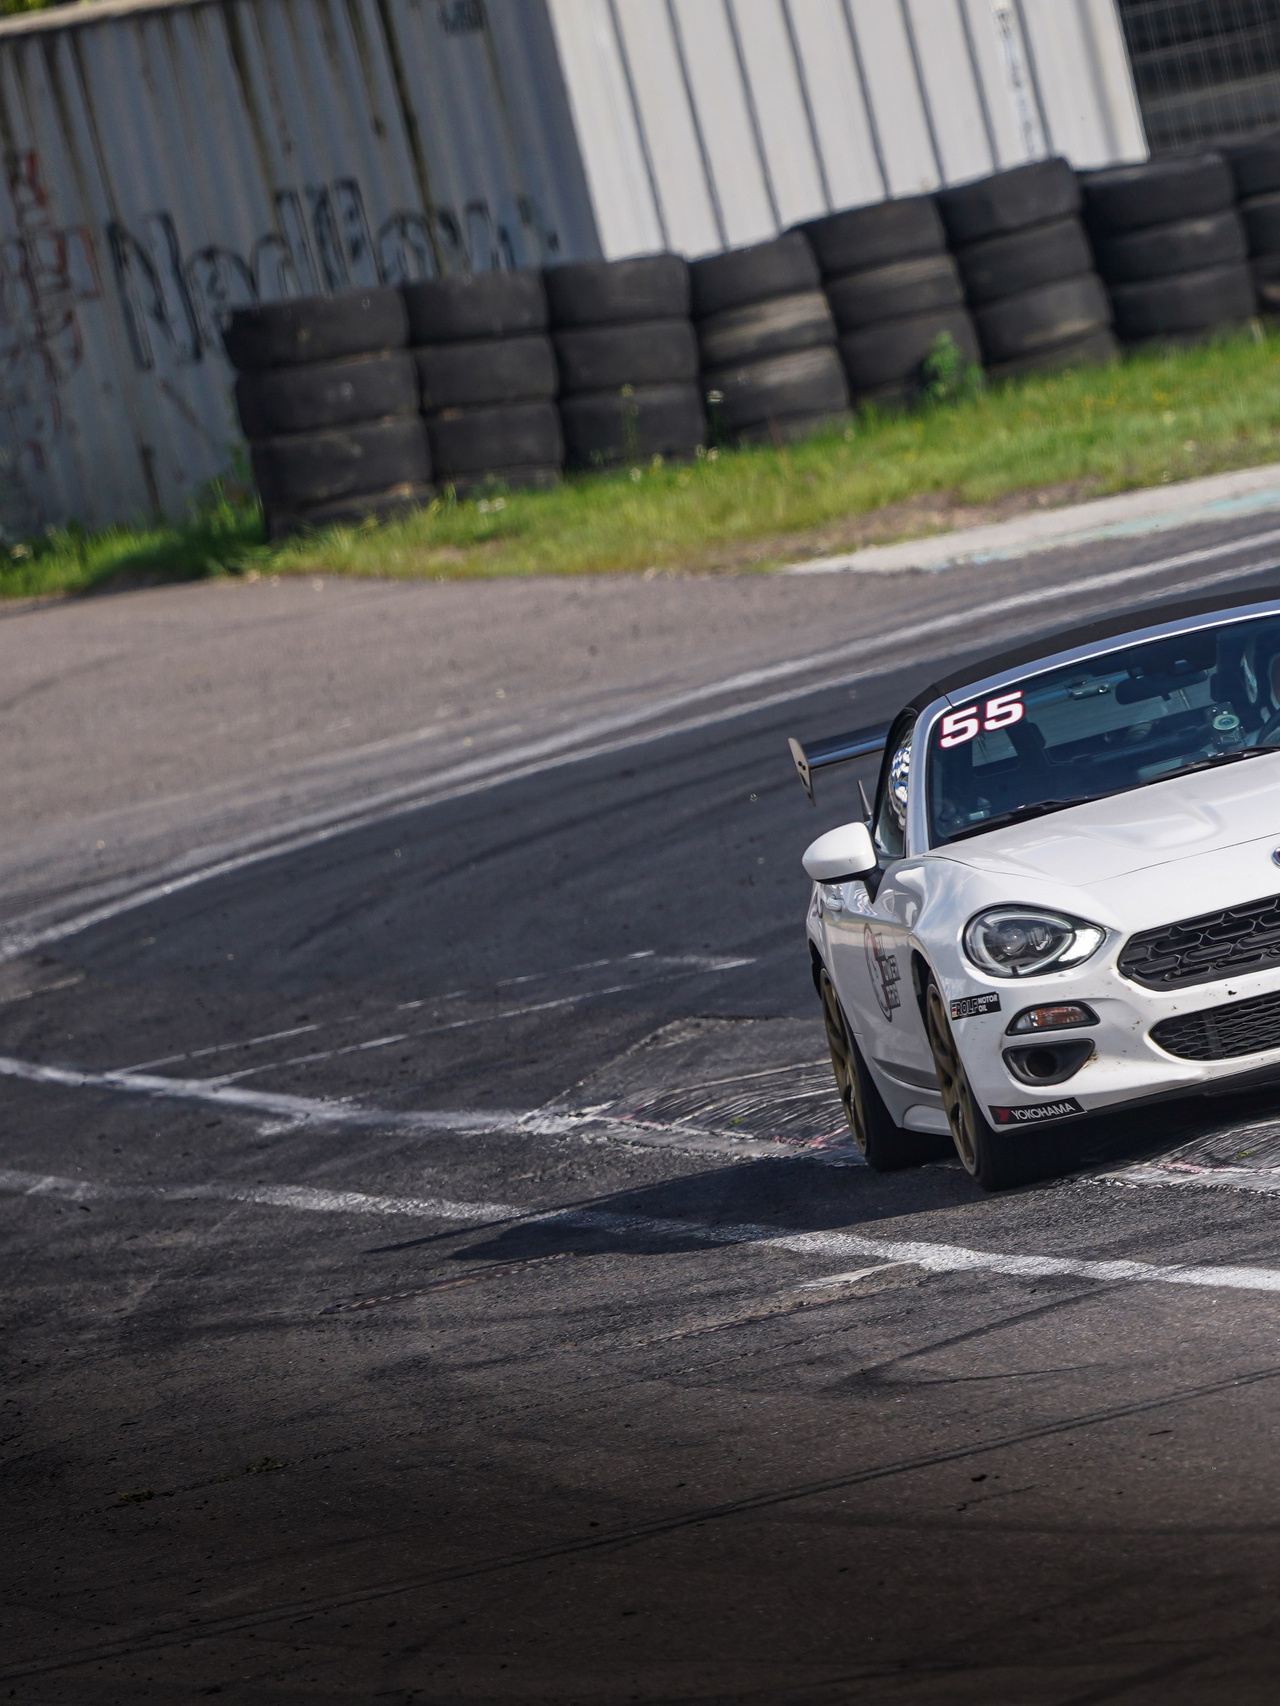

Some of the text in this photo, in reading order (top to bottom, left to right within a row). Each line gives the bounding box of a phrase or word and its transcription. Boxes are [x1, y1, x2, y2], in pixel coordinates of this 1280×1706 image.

[939, 690, 1025, 749] 55
[955, 994, 998, 1017] ROLF MOTOR
[978, 1004, 988, 1012] OIL
[1011, 1102, 1076, 1120] YOKOHAMA
